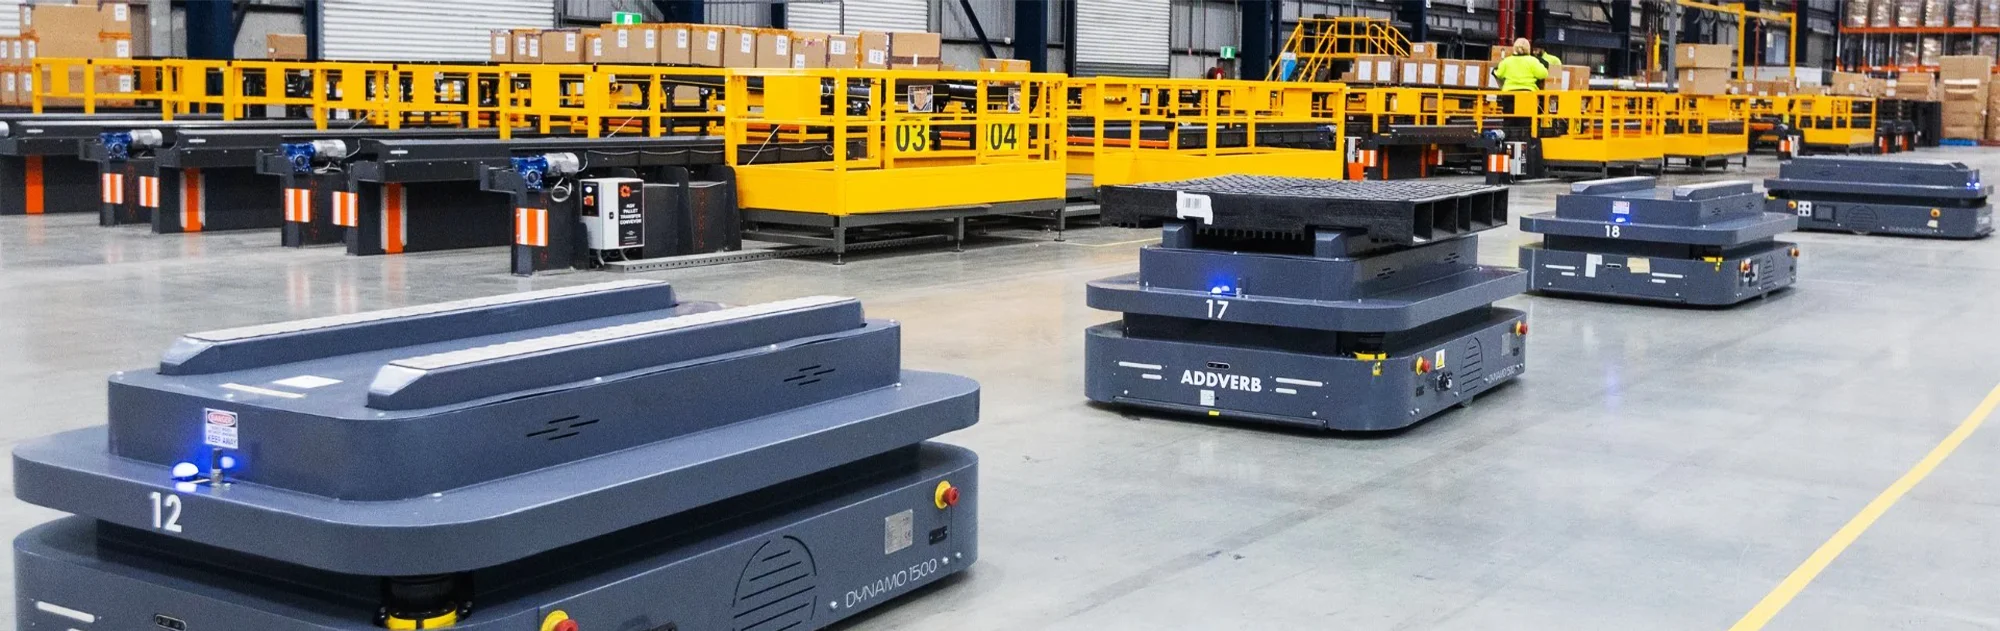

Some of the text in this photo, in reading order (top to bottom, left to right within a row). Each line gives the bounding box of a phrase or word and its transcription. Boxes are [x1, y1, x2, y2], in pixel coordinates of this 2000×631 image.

[896, 118, 926, 152] 03
[990, 122, 1018, 151] 04
[1605, 225, 1620, 238] 18
[1206, 299, 1229, 319] 17
[1181, 369, 1262, 393] ADDVERB
[151, 491, 182, 532] 12
[846, 558, 938, 608] DYNAMO 1500
